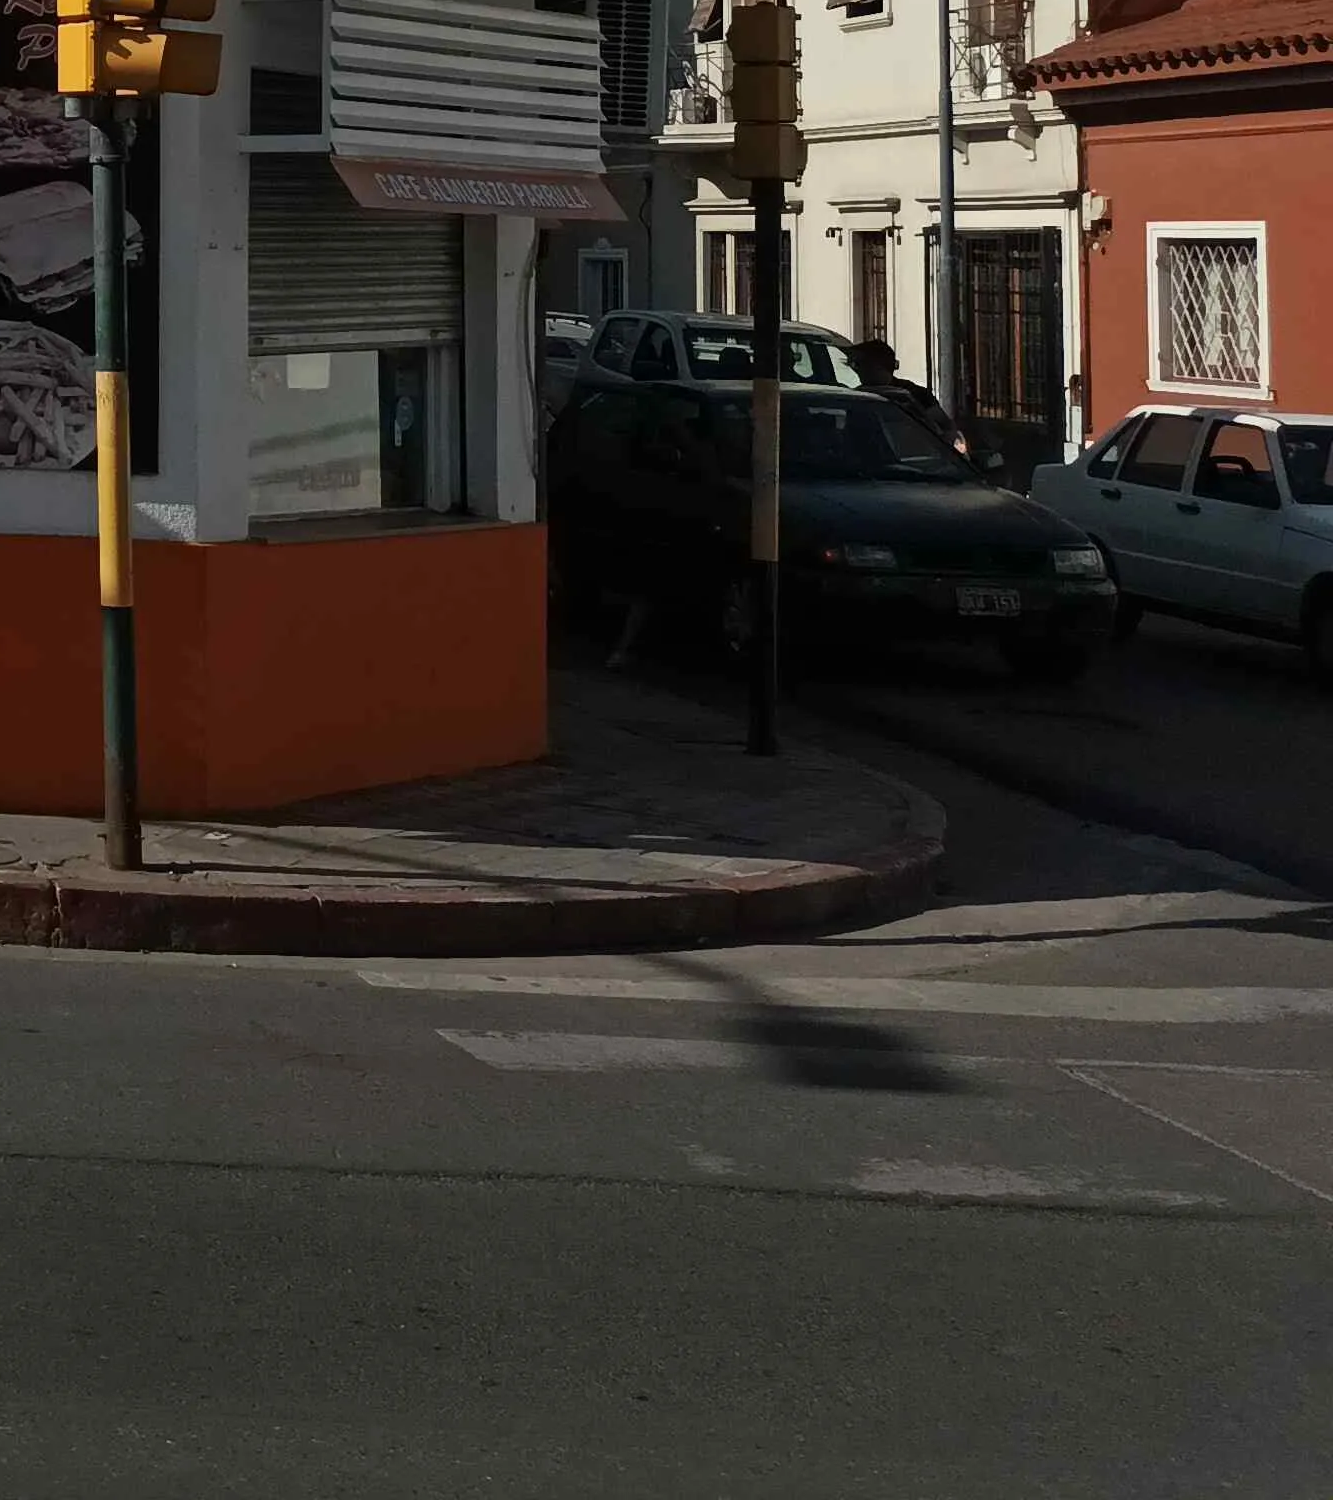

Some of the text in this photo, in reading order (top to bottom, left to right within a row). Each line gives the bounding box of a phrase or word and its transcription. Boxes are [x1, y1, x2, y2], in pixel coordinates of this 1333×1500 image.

[374, 172, 595, 209] CAFE ALMUERZO PARRILLA
